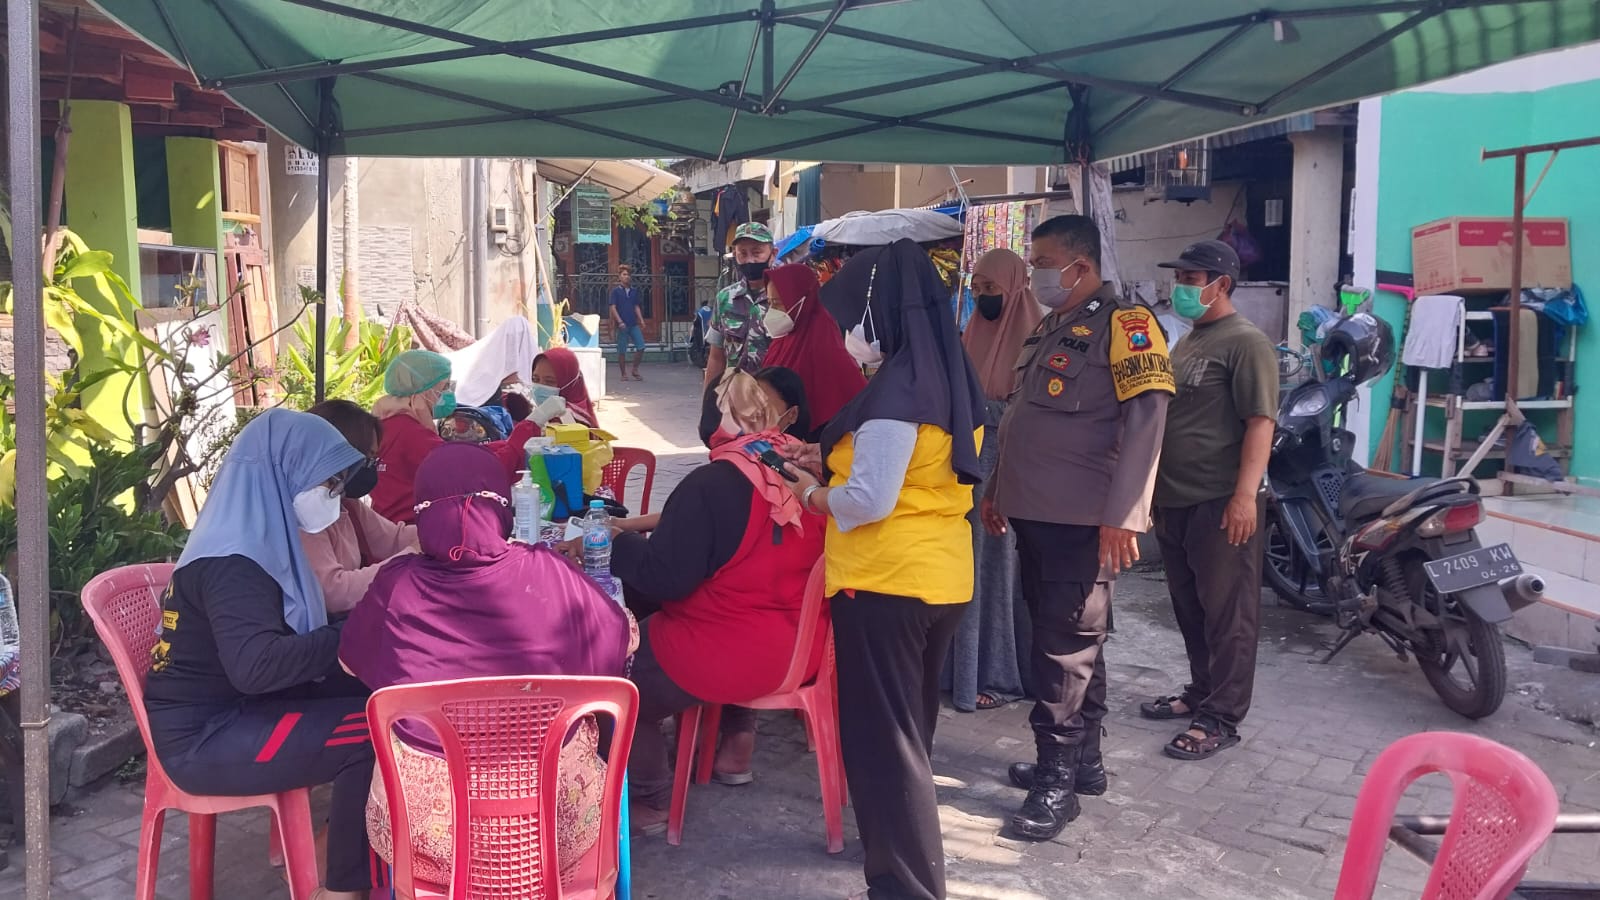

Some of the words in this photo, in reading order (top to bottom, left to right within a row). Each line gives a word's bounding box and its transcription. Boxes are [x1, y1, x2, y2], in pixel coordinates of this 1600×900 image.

[1057, 337, 1090, 353] POLRI
[1428, 564, 1440, 578] L
[1489, 546, 1513, 562] KW
